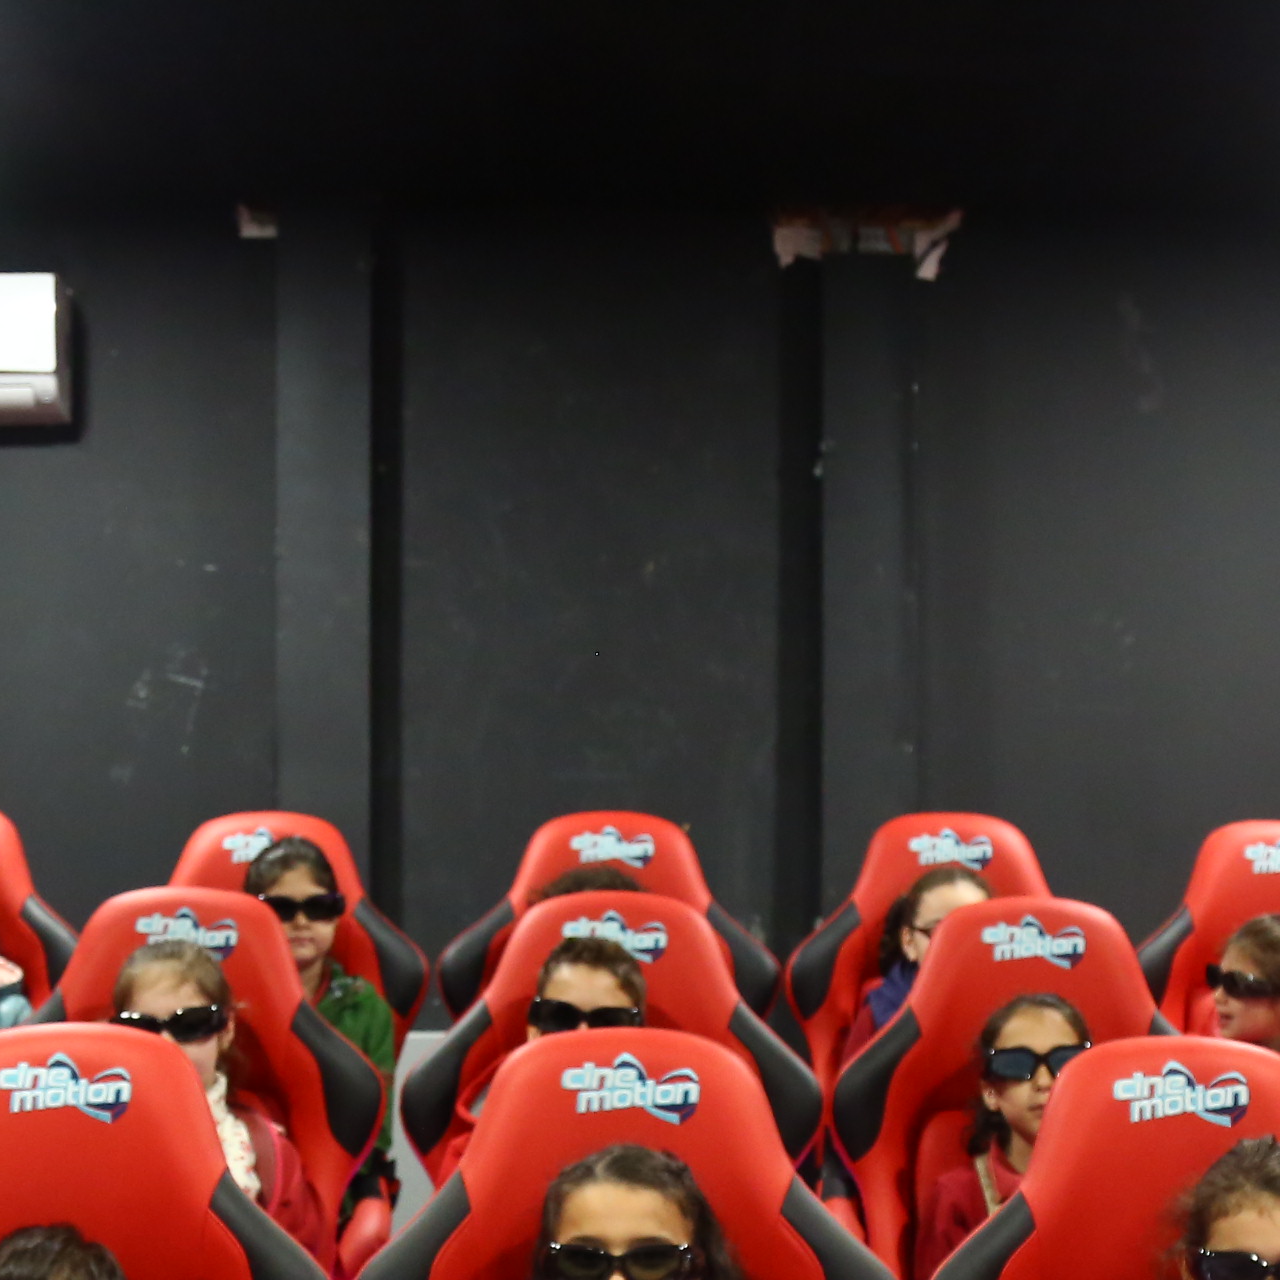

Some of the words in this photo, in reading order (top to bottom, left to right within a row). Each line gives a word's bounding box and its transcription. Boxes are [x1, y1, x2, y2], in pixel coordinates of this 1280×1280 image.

[982, 922, 1040, 944] cine
[994, 934, 1086, 961] motion
[561, 1062, 638, 1090] cine
[1113, 1071, 1188, 1100] cine
[10, 1078, 132, 1114] motion
[576, 1079, 700, 1114] motion
[1130, 1084, 1250, 1123] motion
